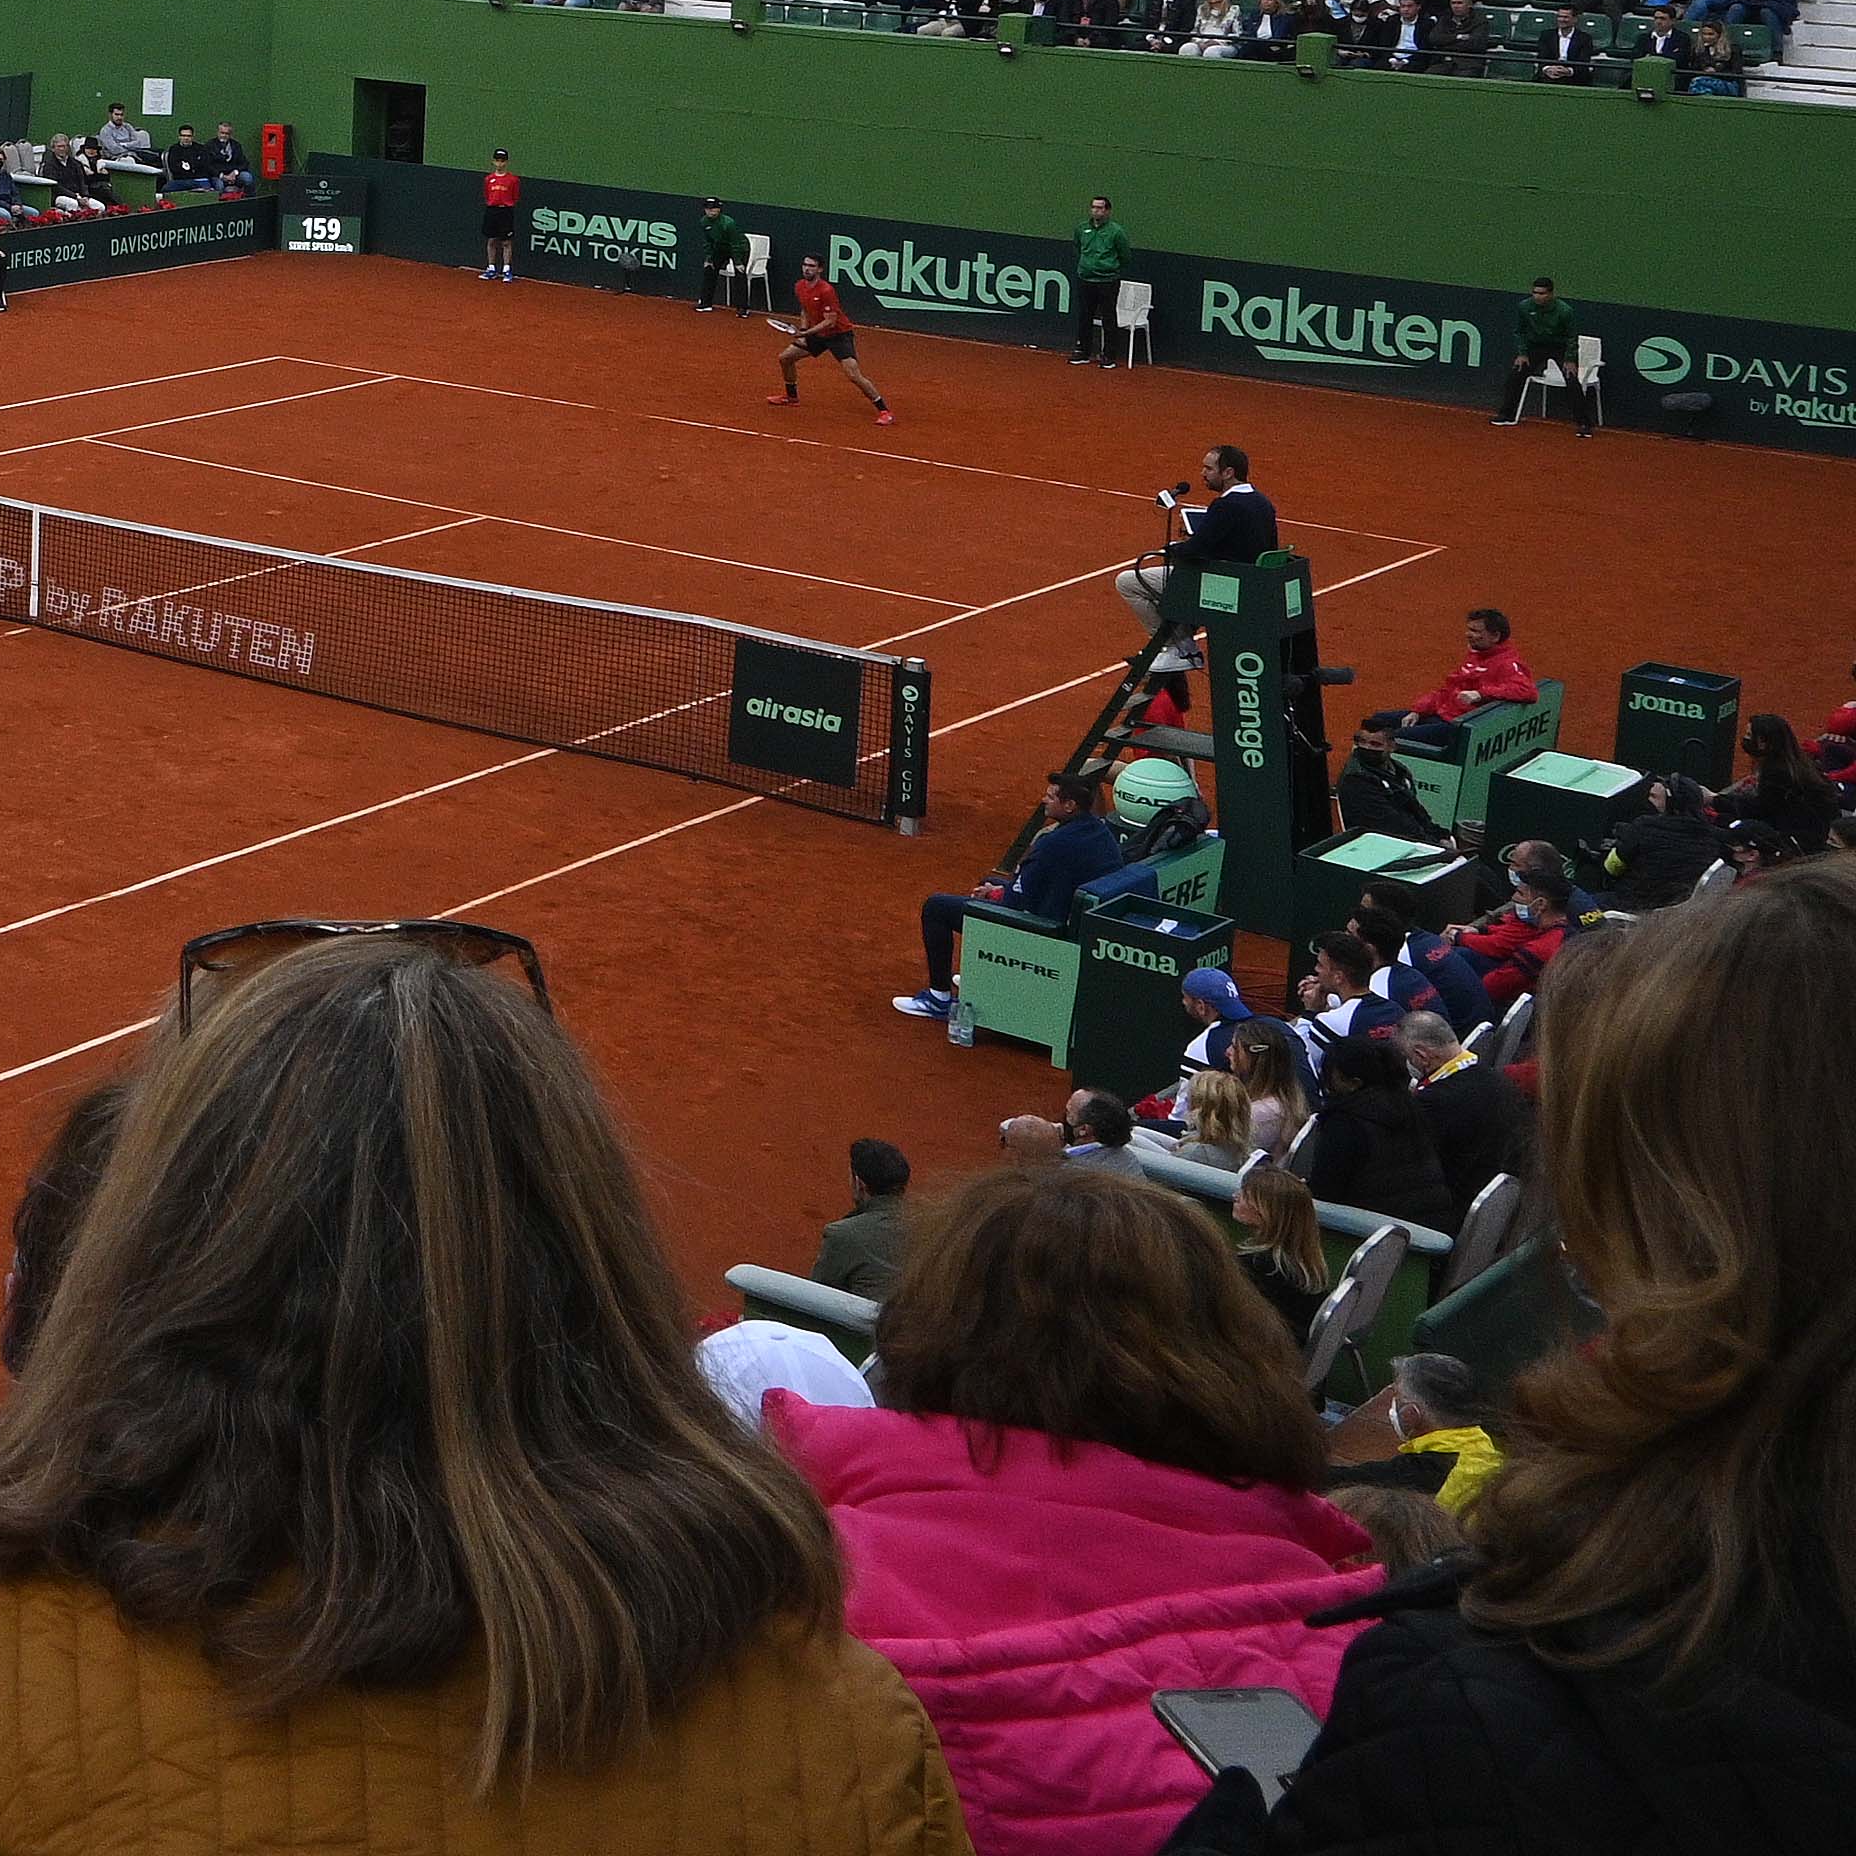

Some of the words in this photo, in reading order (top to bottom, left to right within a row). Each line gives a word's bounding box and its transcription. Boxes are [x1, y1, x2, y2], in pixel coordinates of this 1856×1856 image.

[110, 217, 255, 257] DAVISCUPFINALS.COM
[301, 217, 341, 241] 159
[531, 206, 678, 247] $DAVIS
[6, 247, 52, 271] IFIERS
[55, 243, 86, 263] 2022
[530, 235, 581, 257] FAN
[588, 242, 678, 270] TOKEN
[827, 233, 1072, 314] Rakuten
[1200, 279, 1483, 368] Rakuten
[1706, 352, 1848, 396] DAVIS
[1749, 398, 1769, 415] by
[1775, 393, 1856, 425] Rakut
[45, 577, 91, 626] by
[102, 586, 316, 675] RAKUTEN
[746, 697, 843, 733] airasia
[903, 701, 917, 759] DAVIS
[1234, 651, 1265, 769] Orange
[1474, 709, 1551, 767] MAPFRE
[901, 770, 914, 803] CUP
[1162, 870, 1210, 906] FRE
[978, 948, 1061, 981] MAPFRE
